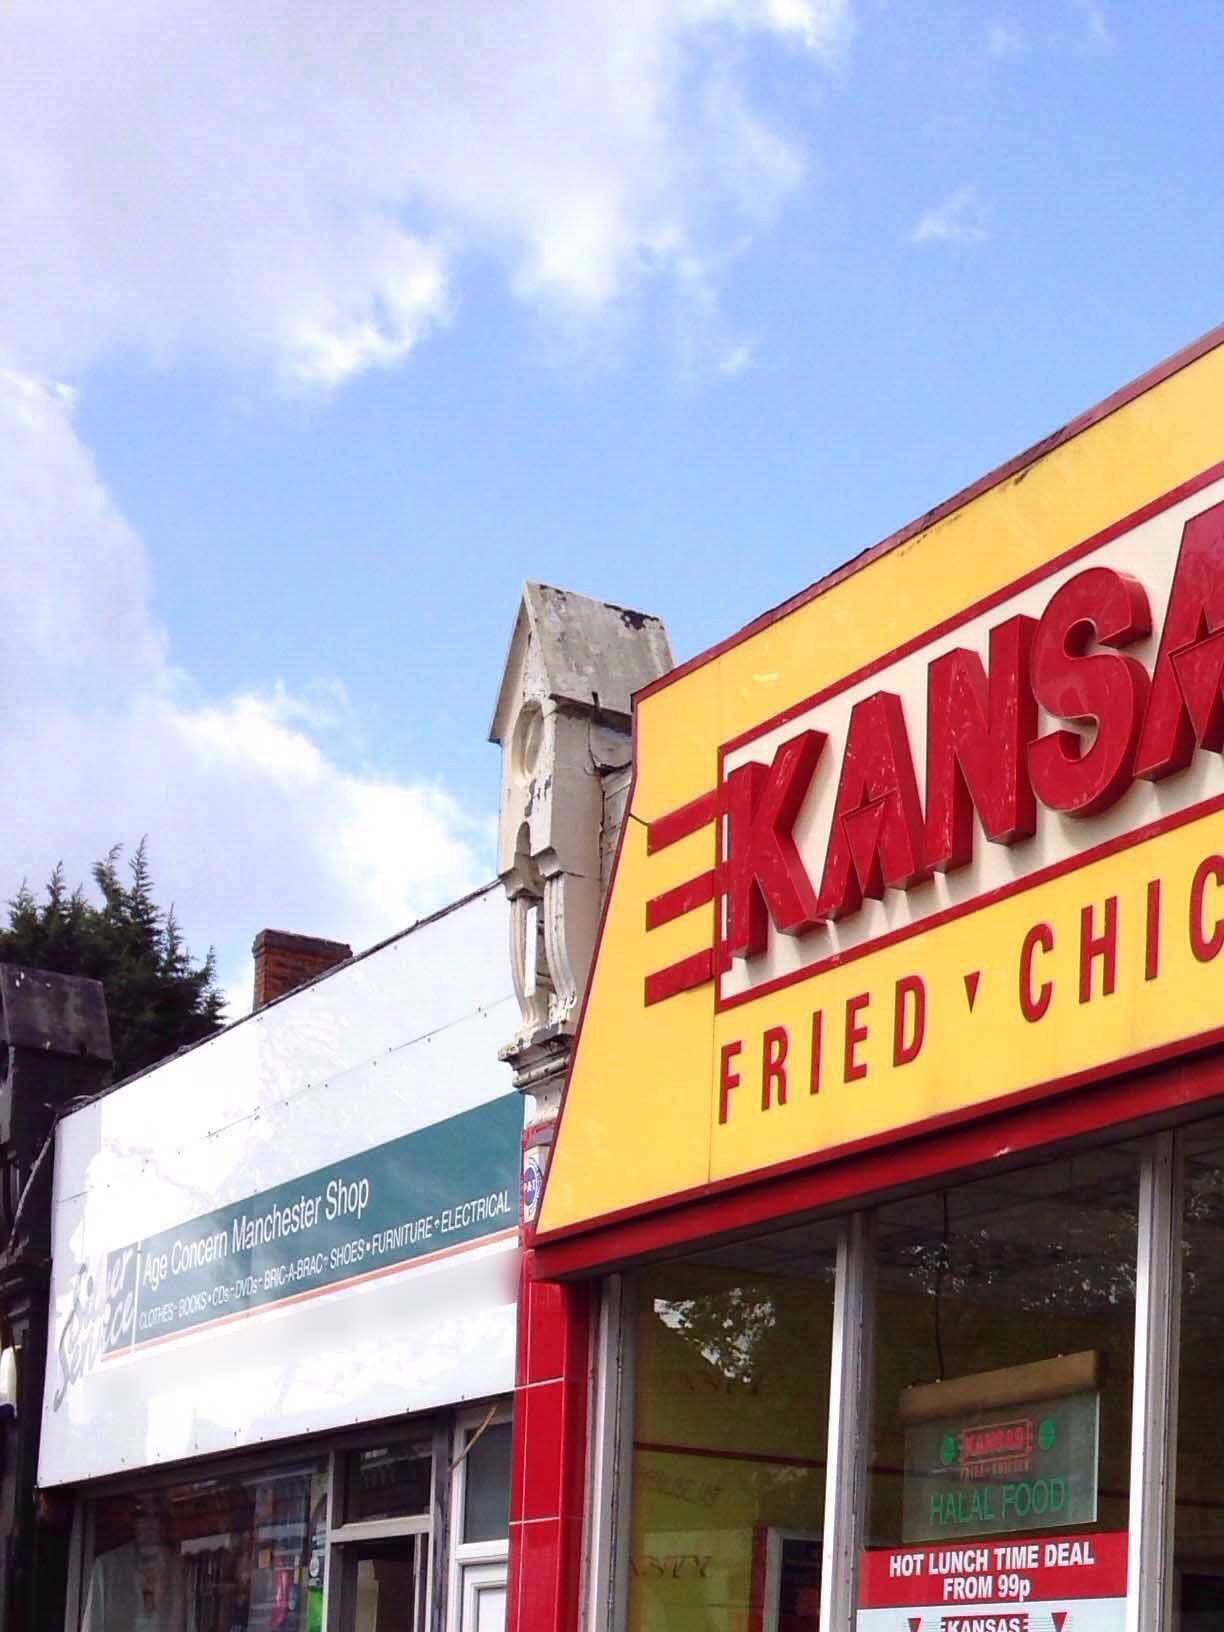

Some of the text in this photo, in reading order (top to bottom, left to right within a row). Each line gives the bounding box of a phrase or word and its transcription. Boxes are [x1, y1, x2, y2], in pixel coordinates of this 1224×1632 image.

[718, 975, 925, 1125] FRIED
[139, 1301, 175, 1331] CLOTHES
[235, 1276, 258, 1299] DVDs
[263, 1252, 323, 1291] BRIC-A-BRAC
[330, 1239, 365, 1269] SHOES
[371, 1216, 434, 1256] FURNITURE
[441, 1190, 511, 1233] ELECTRICAL
[142, 1251, 168, 1292] Age
[171, 1231, 228, 1276] Concern
[232, 1198, 323, 1253] Manchester
[325, 1177, 370, 1220] Shop
[929, 1477, 1069, 1527] HALAL FOOD
[889, 1541, 1095, 1578] HOT LUNCH TIME DEAL
[943, 1573, 1031, 1602] FROM 99p
